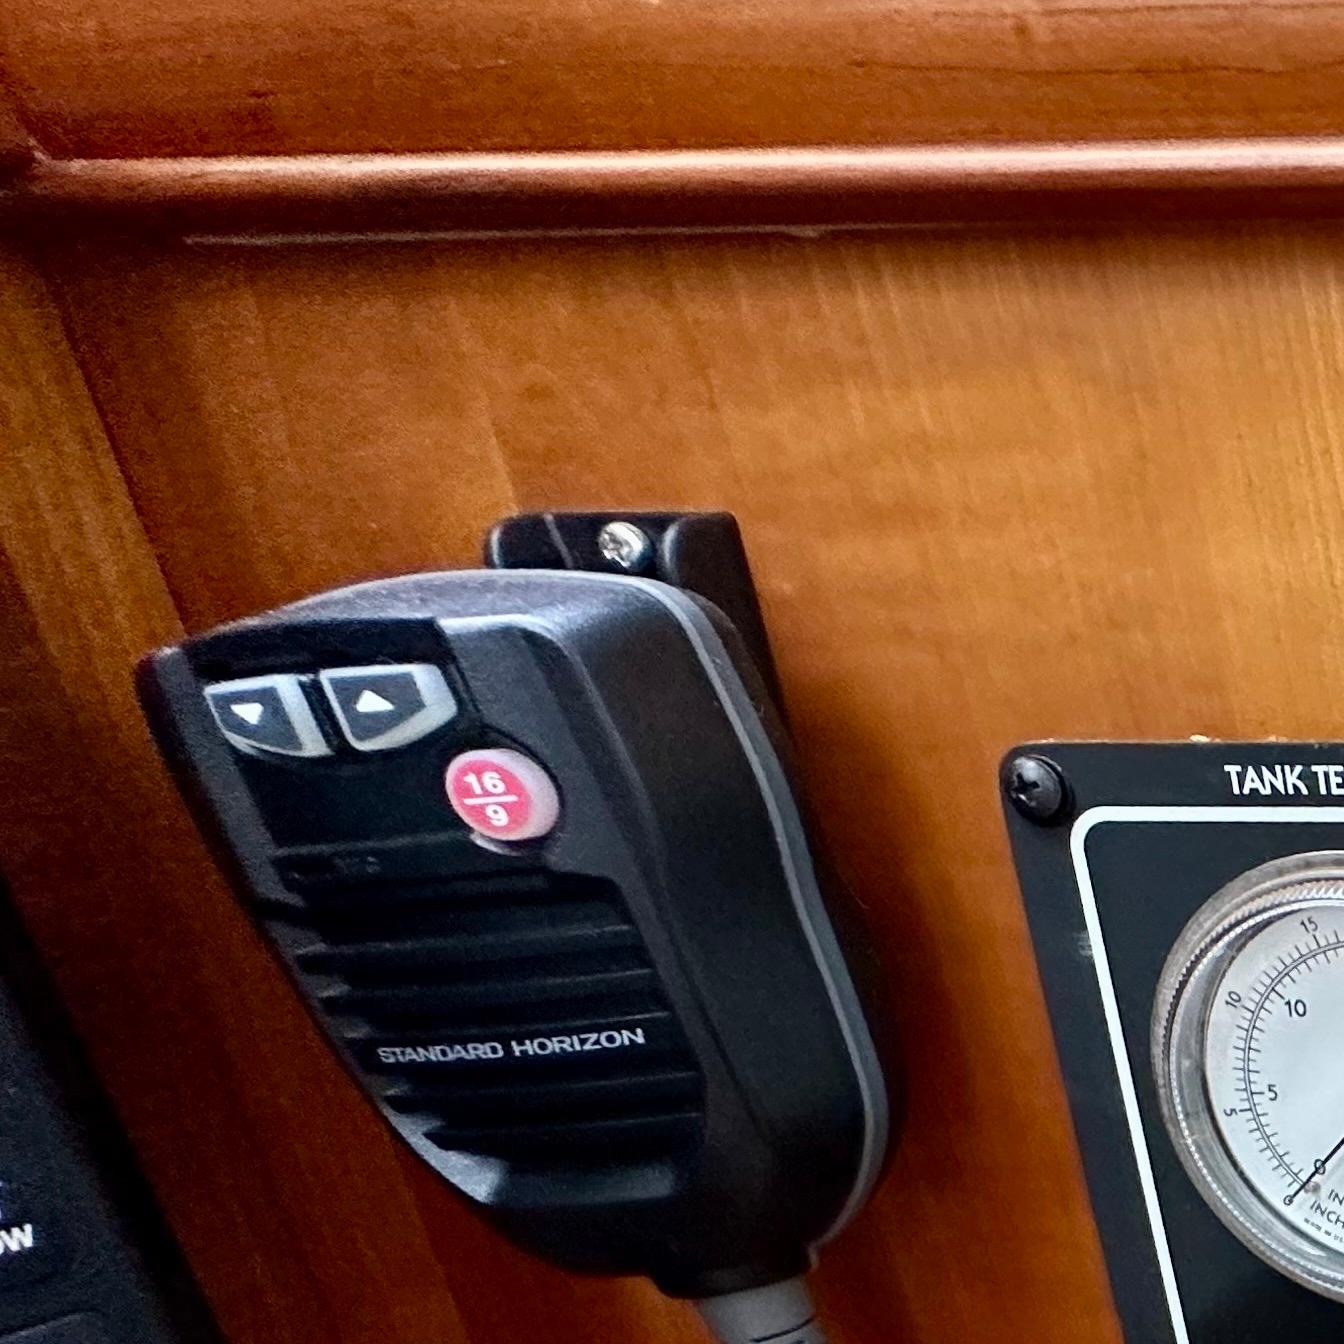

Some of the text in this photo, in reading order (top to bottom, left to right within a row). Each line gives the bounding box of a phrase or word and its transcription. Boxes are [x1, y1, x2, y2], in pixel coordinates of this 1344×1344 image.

[464, 772, 504, 794] 16
[1224, 765, 1308, 795] TANK
[486, 804, 508, 826] 9
[1285, 999, 1306, 1017] 10
[377, 1028, 645, 1063] STANDARD HORIZON
[1268, 1084, 1277, 1101] 5
